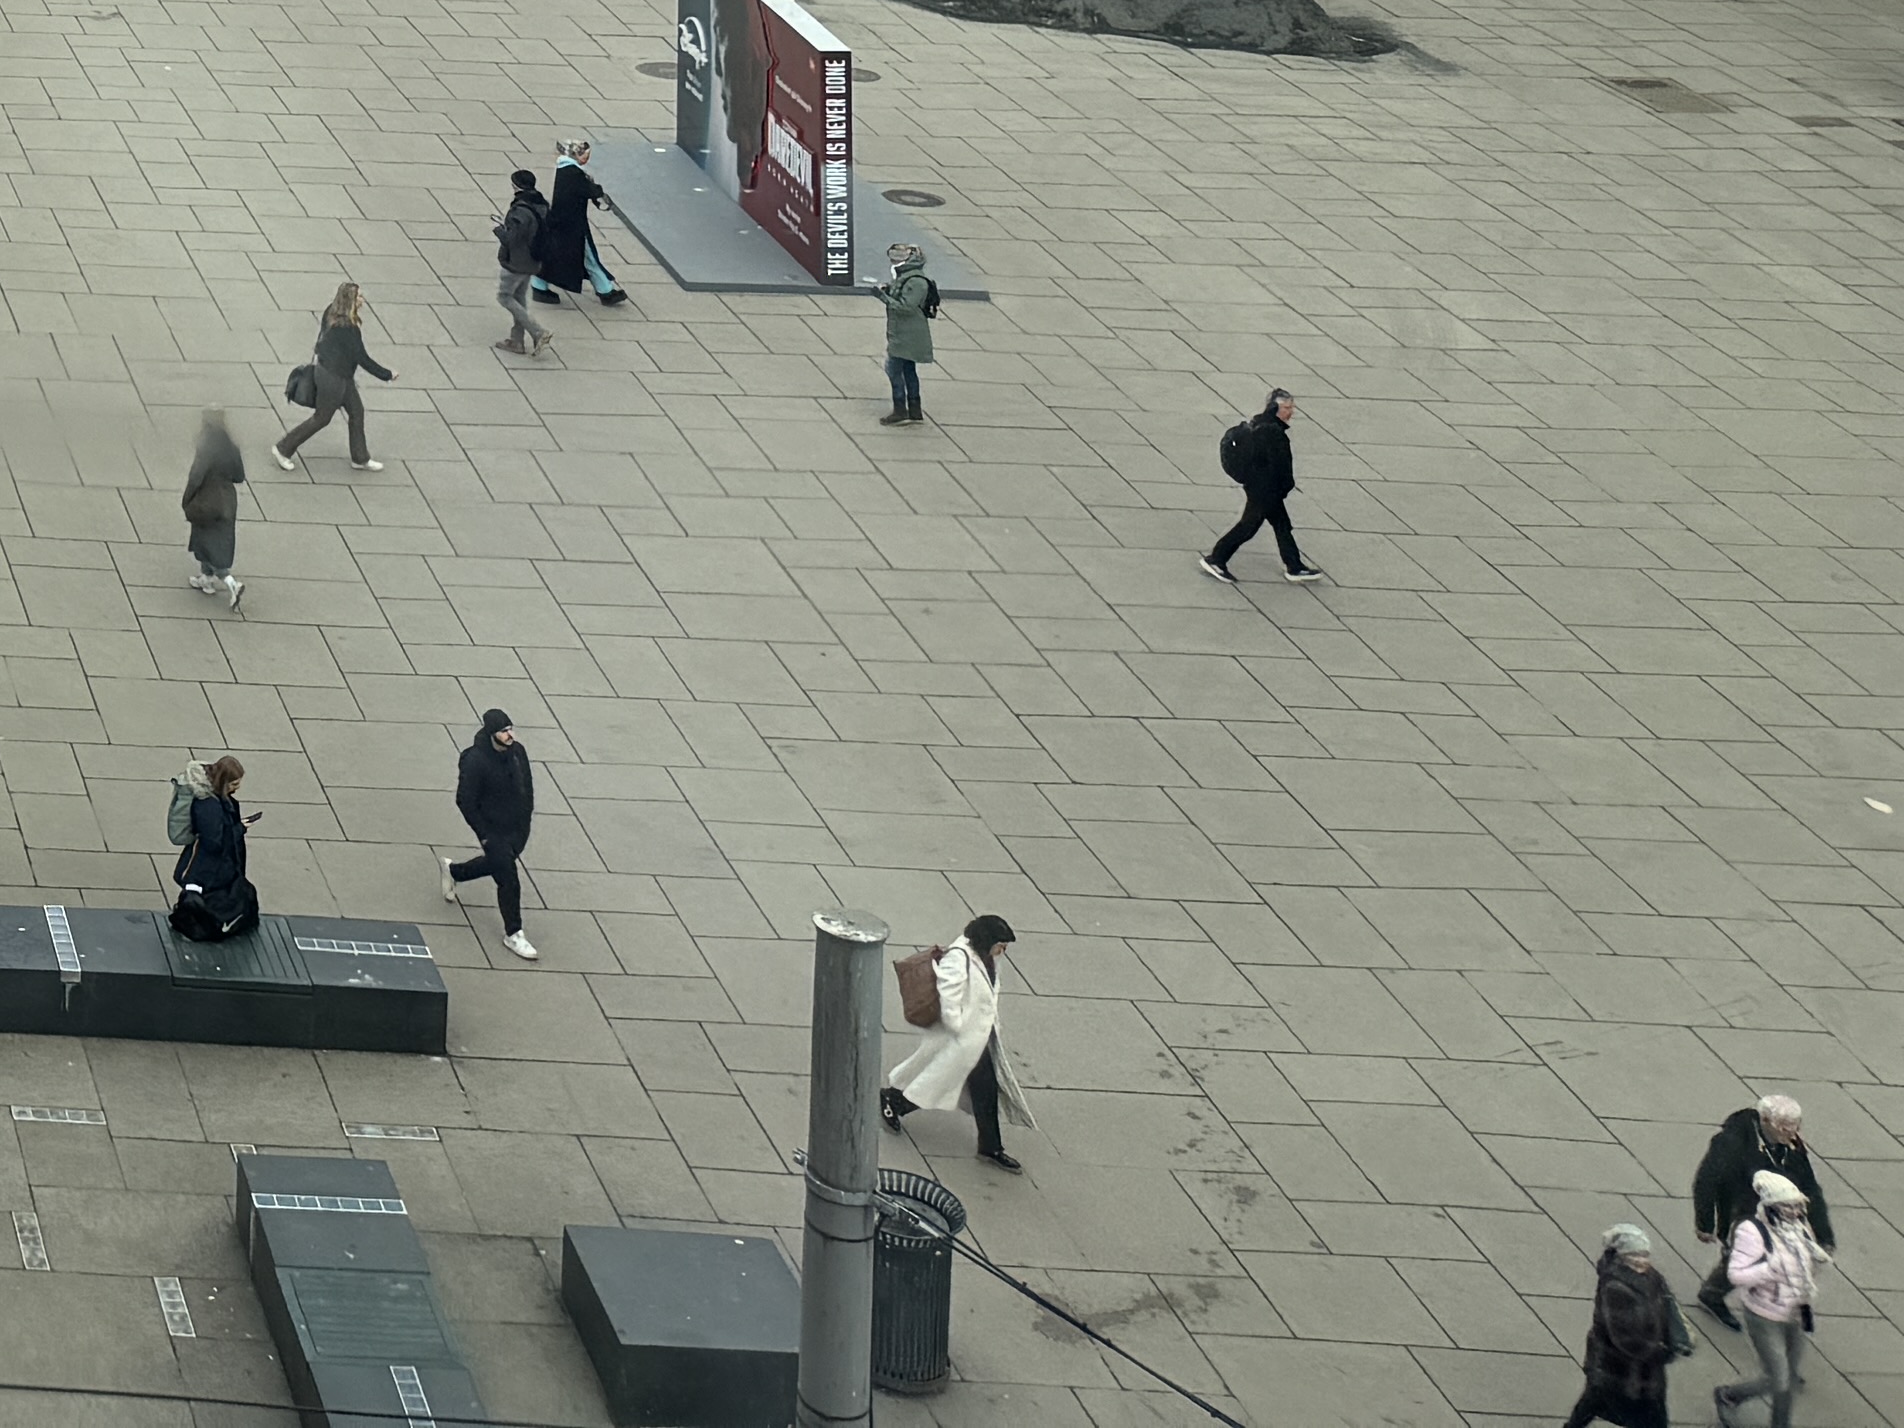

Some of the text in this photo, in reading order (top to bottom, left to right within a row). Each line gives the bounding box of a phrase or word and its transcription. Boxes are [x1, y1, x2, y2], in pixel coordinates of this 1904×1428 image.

[825, 59, 849, 277] THE DEVIL'S WORK IS NEVER DONE
